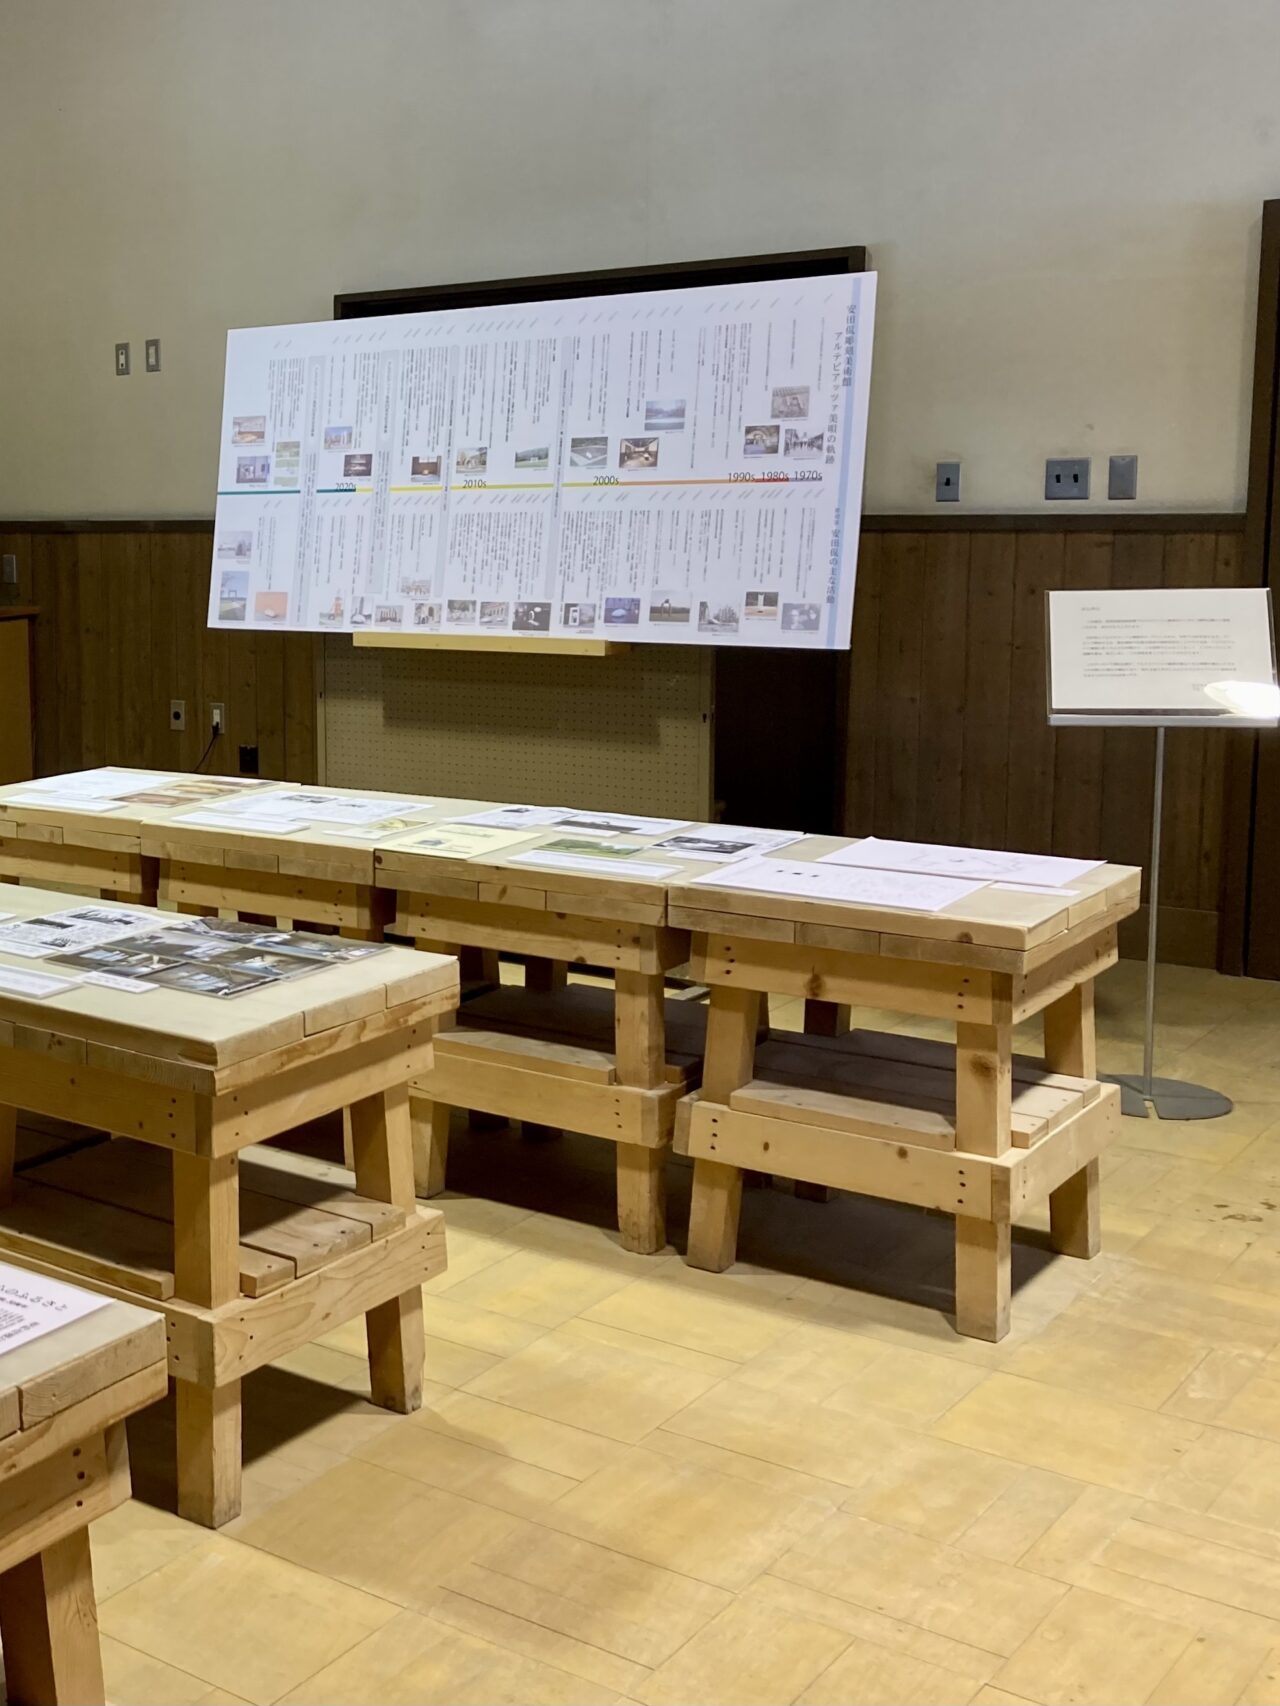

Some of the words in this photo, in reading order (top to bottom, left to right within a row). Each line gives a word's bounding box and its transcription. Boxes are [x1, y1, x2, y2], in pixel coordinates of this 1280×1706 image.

[592, 475, 619, 486] 2000s
[728, 472, 755, 483] 1990s
[761, 471, 789, 482] 1980s
[794, 470, 822, 481] 1970s
[462, 479, 487, 489] 2010s
